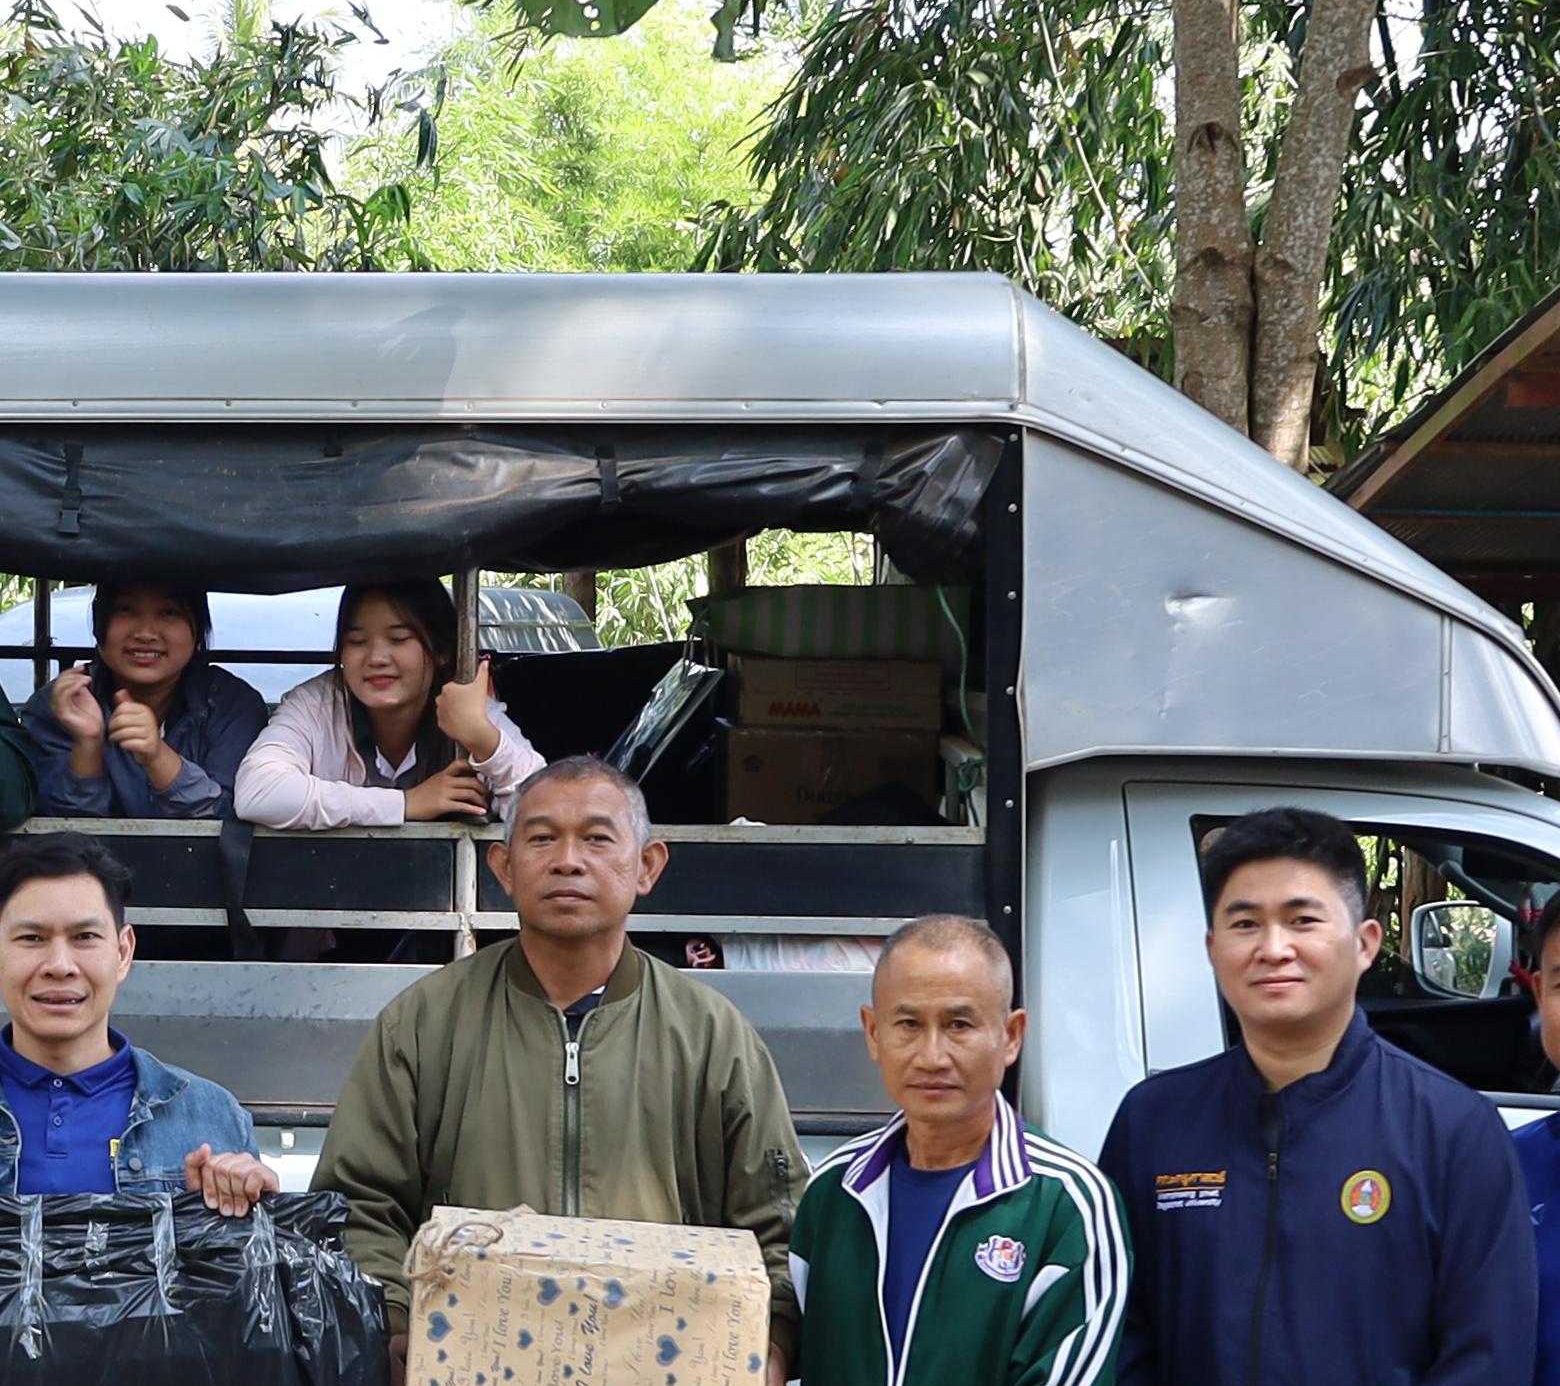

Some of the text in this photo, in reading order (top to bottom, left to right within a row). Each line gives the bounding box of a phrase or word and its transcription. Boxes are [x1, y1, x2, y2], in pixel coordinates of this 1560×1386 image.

[658, 1267, 677, 1298] lov
[492, 1270, 513, 1349] I love You!
[580, 1293, 605, 1336] You!
[722, 1293, 742, 1372] I love You!
[578, 1344, 595, 1376] love
